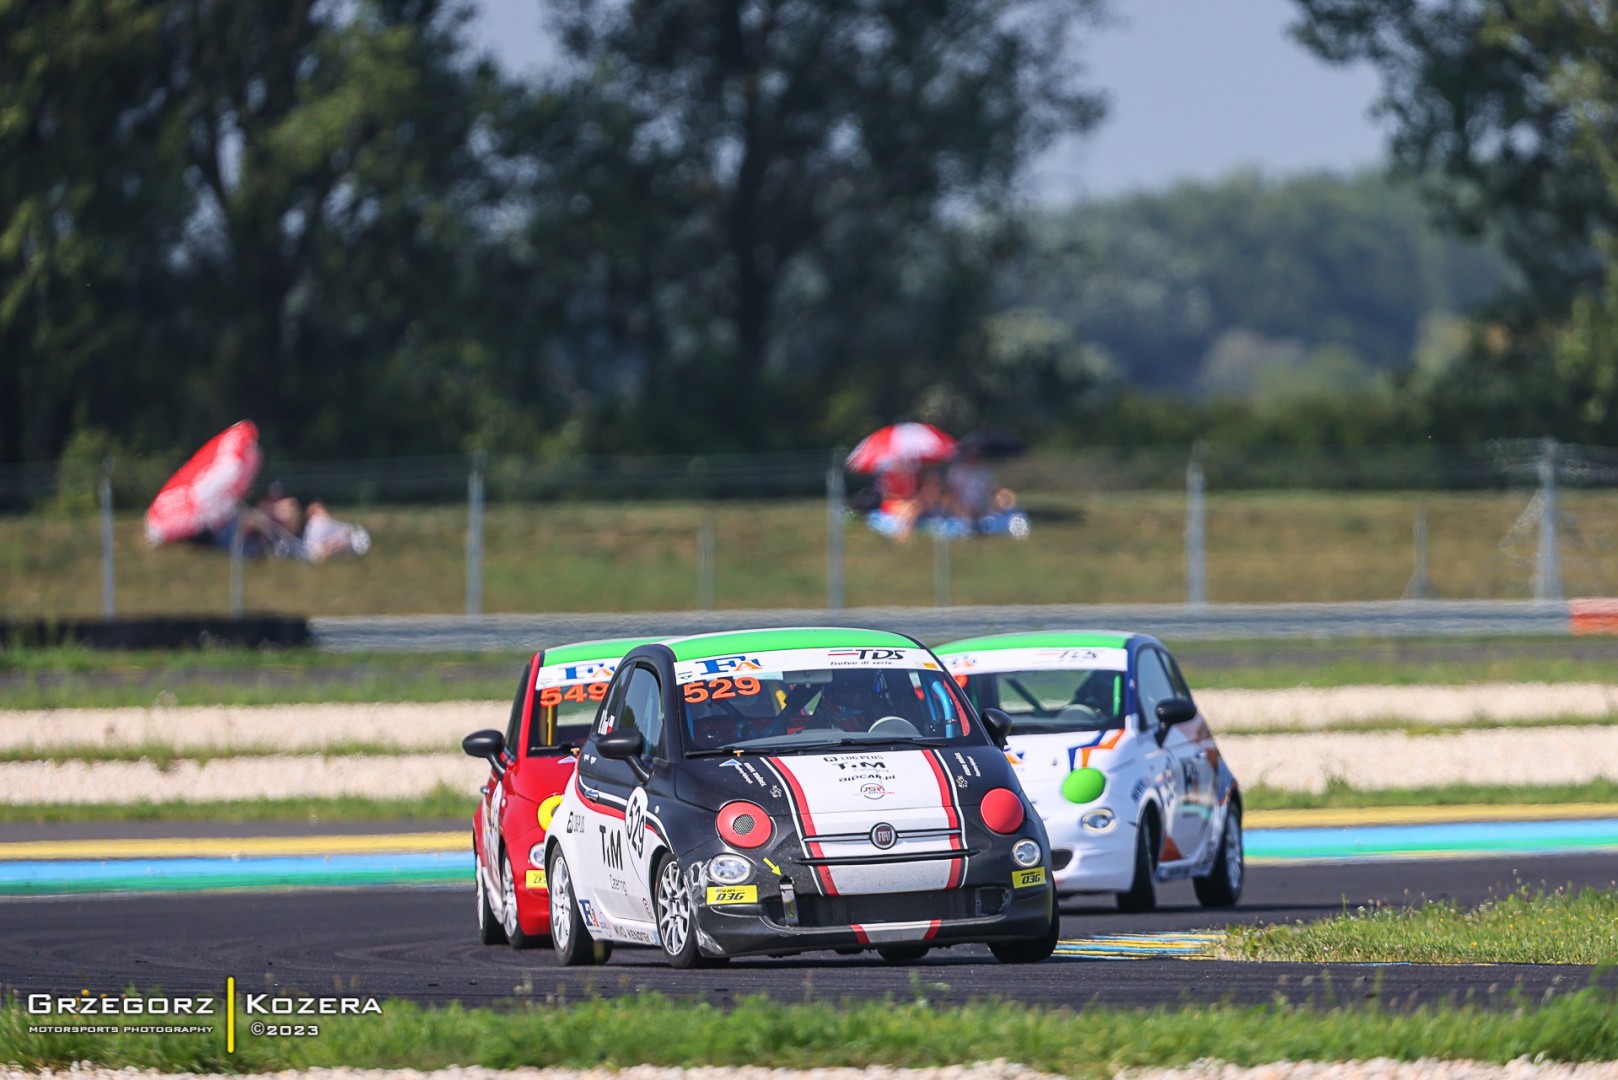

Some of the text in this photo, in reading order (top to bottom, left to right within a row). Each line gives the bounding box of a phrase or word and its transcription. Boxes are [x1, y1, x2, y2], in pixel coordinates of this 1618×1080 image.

[855, 649, 906, 660] TDS
[541, 682, 609, 707] 549
[683, 676, 761, 704] 529
[626, 795, 645, 860] 529
[877, 831, 891, 842] FIAT
